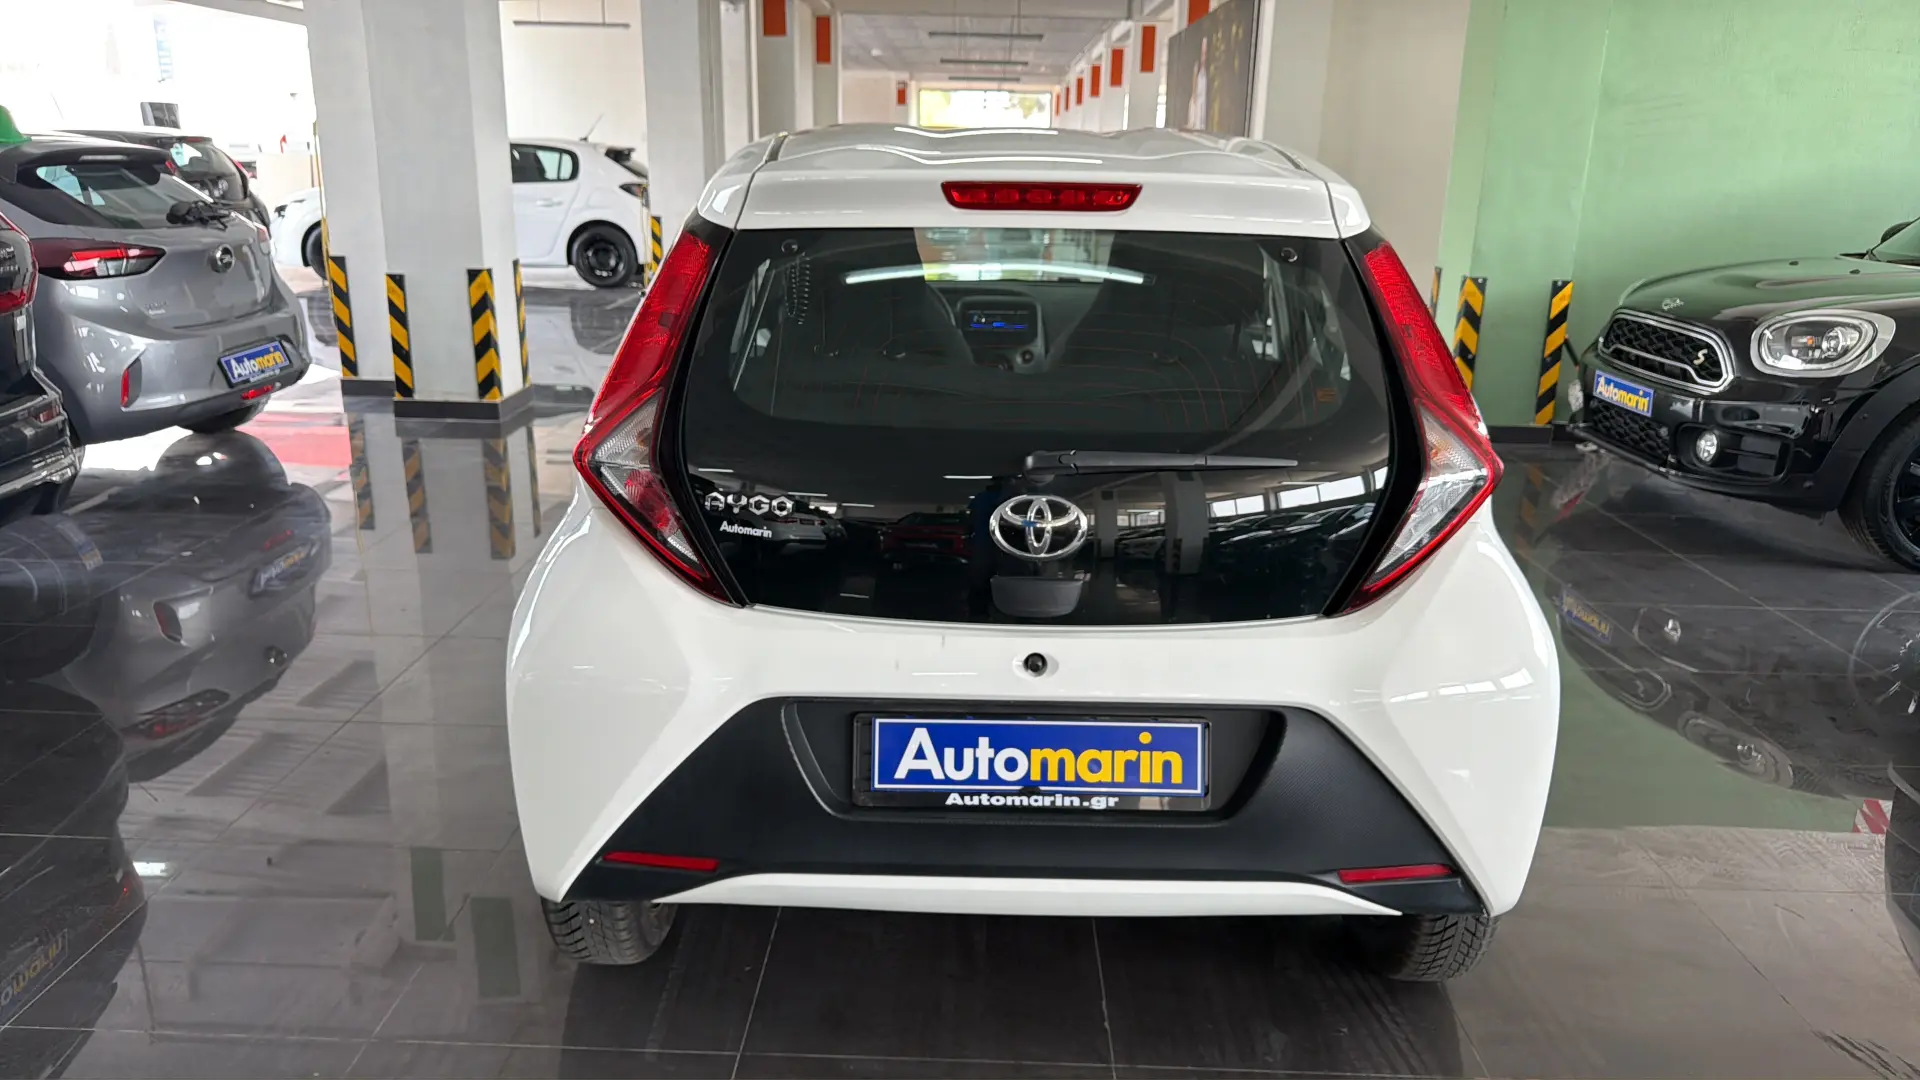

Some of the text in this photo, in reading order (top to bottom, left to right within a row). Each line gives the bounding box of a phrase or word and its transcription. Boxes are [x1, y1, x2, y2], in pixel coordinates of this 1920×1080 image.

[230, 346, 285, 378] Automarin
[1693, 349, 1708, 365] S
[1596, 376, 1650, 412] Automarin
[704, 491, 795, 517] AYGO
[719, 520, 772, 538] Automarin
[893, 727, 1183, 784] Automarin
[944, 792, 1119, 808] Automarin.gr
